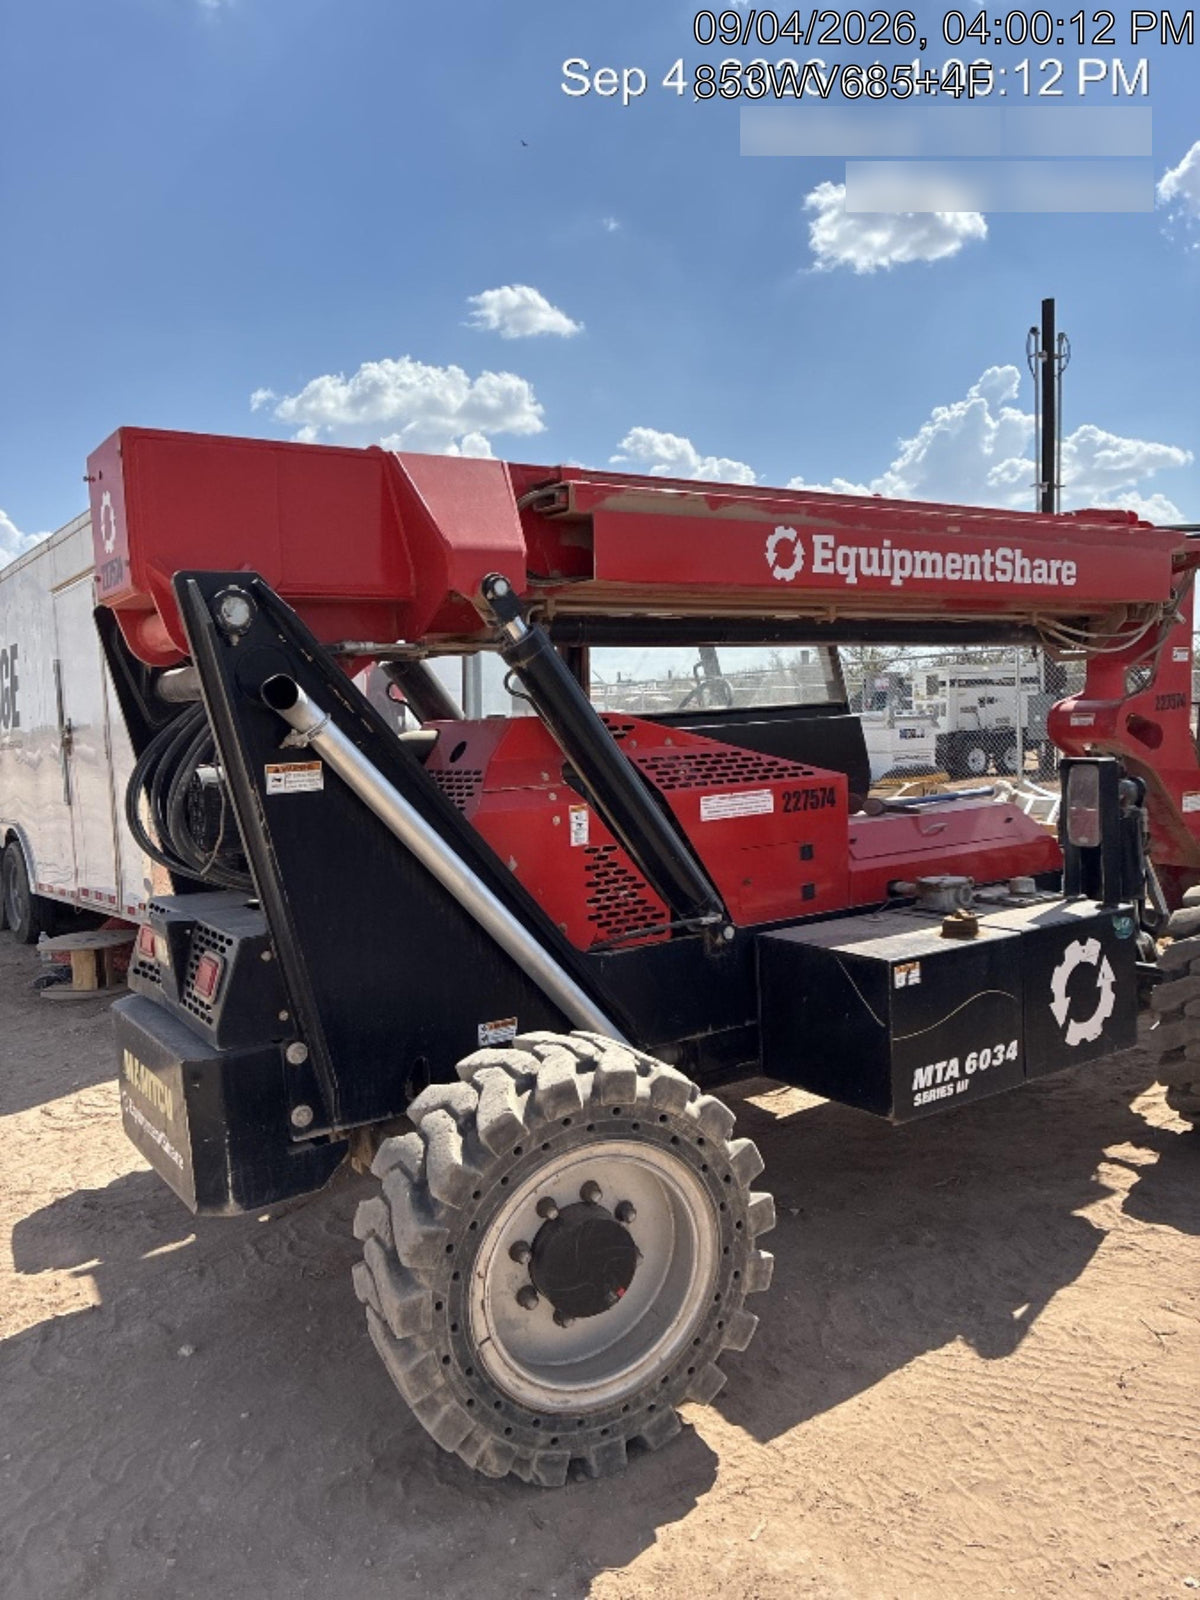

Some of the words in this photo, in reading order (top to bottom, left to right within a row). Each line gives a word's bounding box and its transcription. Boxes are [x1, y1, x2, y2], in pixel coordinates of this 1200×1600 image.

[811, 533, 1078, 587] EquipmentShare
[781, 786, 837, 814] 227574
[911, 1057, 961, 1091] MTA
[964, 1039, 1019, 1075] 6034
[913, 1083, 955, 1107] SERIES
